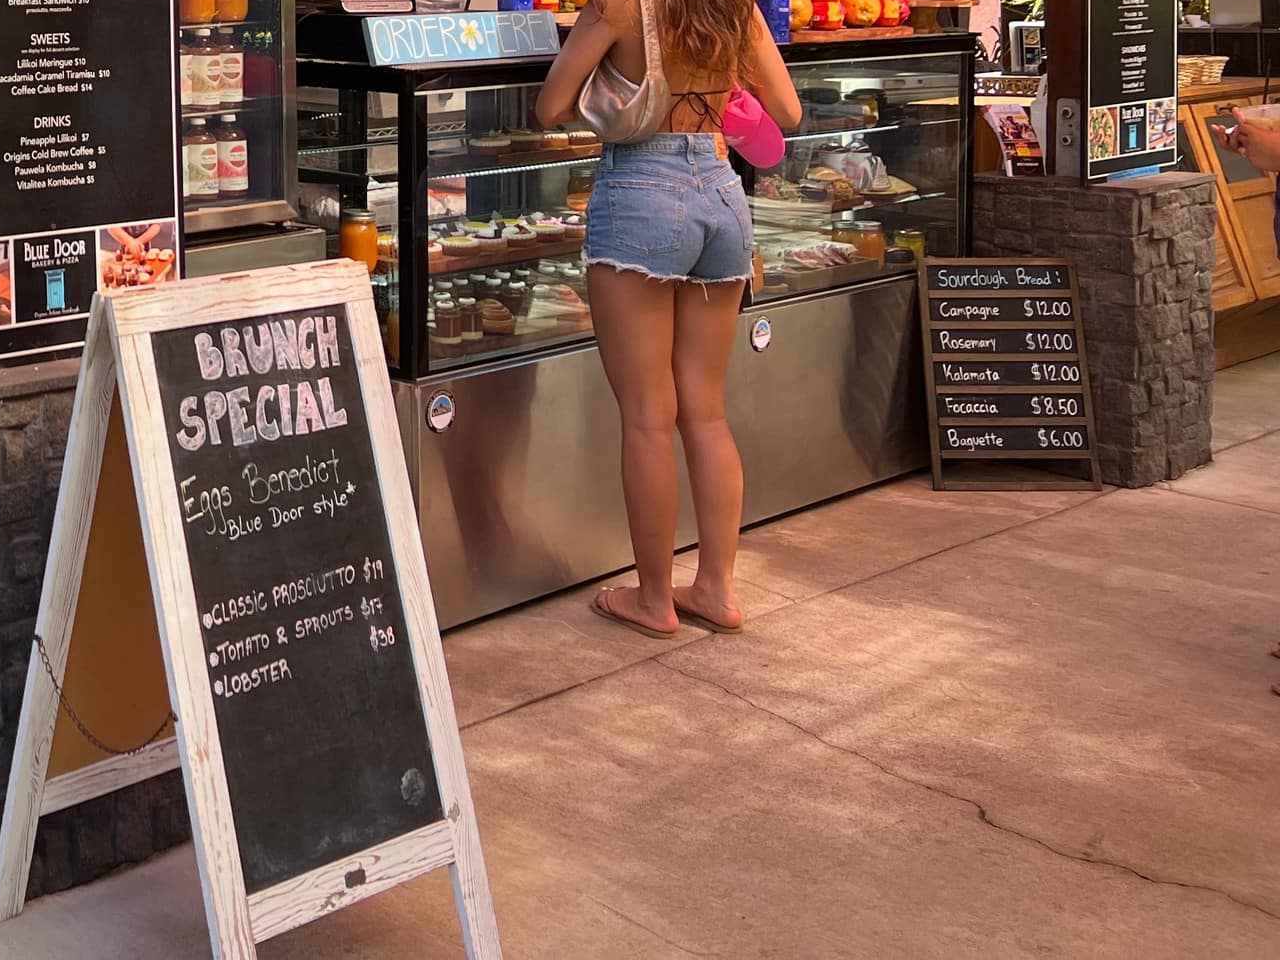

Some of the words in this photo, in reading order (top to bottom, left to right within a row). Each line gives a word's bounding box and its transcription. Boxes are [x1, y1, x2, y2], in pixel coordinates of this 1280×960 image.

[30, 32, 70, 46] SWEETS
[372, 15, 462, 63] ORDER
[481, 13, 548, 55] HERE
[39, 59, 73, 69] Meringue
[74, 58, 86, 66] $10
[35, 71, 64, 81] Caramel
[66, 70, 95, 80] Tiramisu
[99, 70, 110, 78] $10
[11, 85, 36, 96] Coffee
[37, 84, 56, 94] Cake
[57, 83, 78, 93] Bread
[81, 83, 93, 92] $14
[34, 115, 71, 129] DRINKS
[20, 134, 56, 147] Pineapple
[81, 133, 90, 141] $7
[3, 152, 30, 163] Origins
[31, 150, 49, 161] Cold
[50, 149, 69, 159] Brew
[70, 146, 94, 157] Coffee
[46, 162, 84, 173] Kombucha
[47, 176, 85, 187] Kombucha
[24, 242, 50, 262] BLUE
[54, 239, 86, 257] DOOR
[62, 256, 79, 265] PIZZA
[938, 269, 1008, 289] Sourdough
[939, 301, 1000, 320] Campagne
[194, 316, 341, 380] BRUNCH
[939, 331, 996, 352] Rosemary
[942, 363, 1000, 382] Kalamata
[176, 376, 348, 451] SPECIAL
[945, 397, 999, 414] Focaccia
[947, 428, 1004, 452] Baguette
[180, 474, 233, 536] Eggs
[242, 448, 340, 505] Benedict
[271, 505, 305, 529] Door
[363, 557, 385, 584] $19
[217, 633, 270, 666] TOMATO
[295, 605, 354, 640] SPROUTS
[361, 596, 384, 622] $17
[223, 658, 293, 698] LOBSTER
